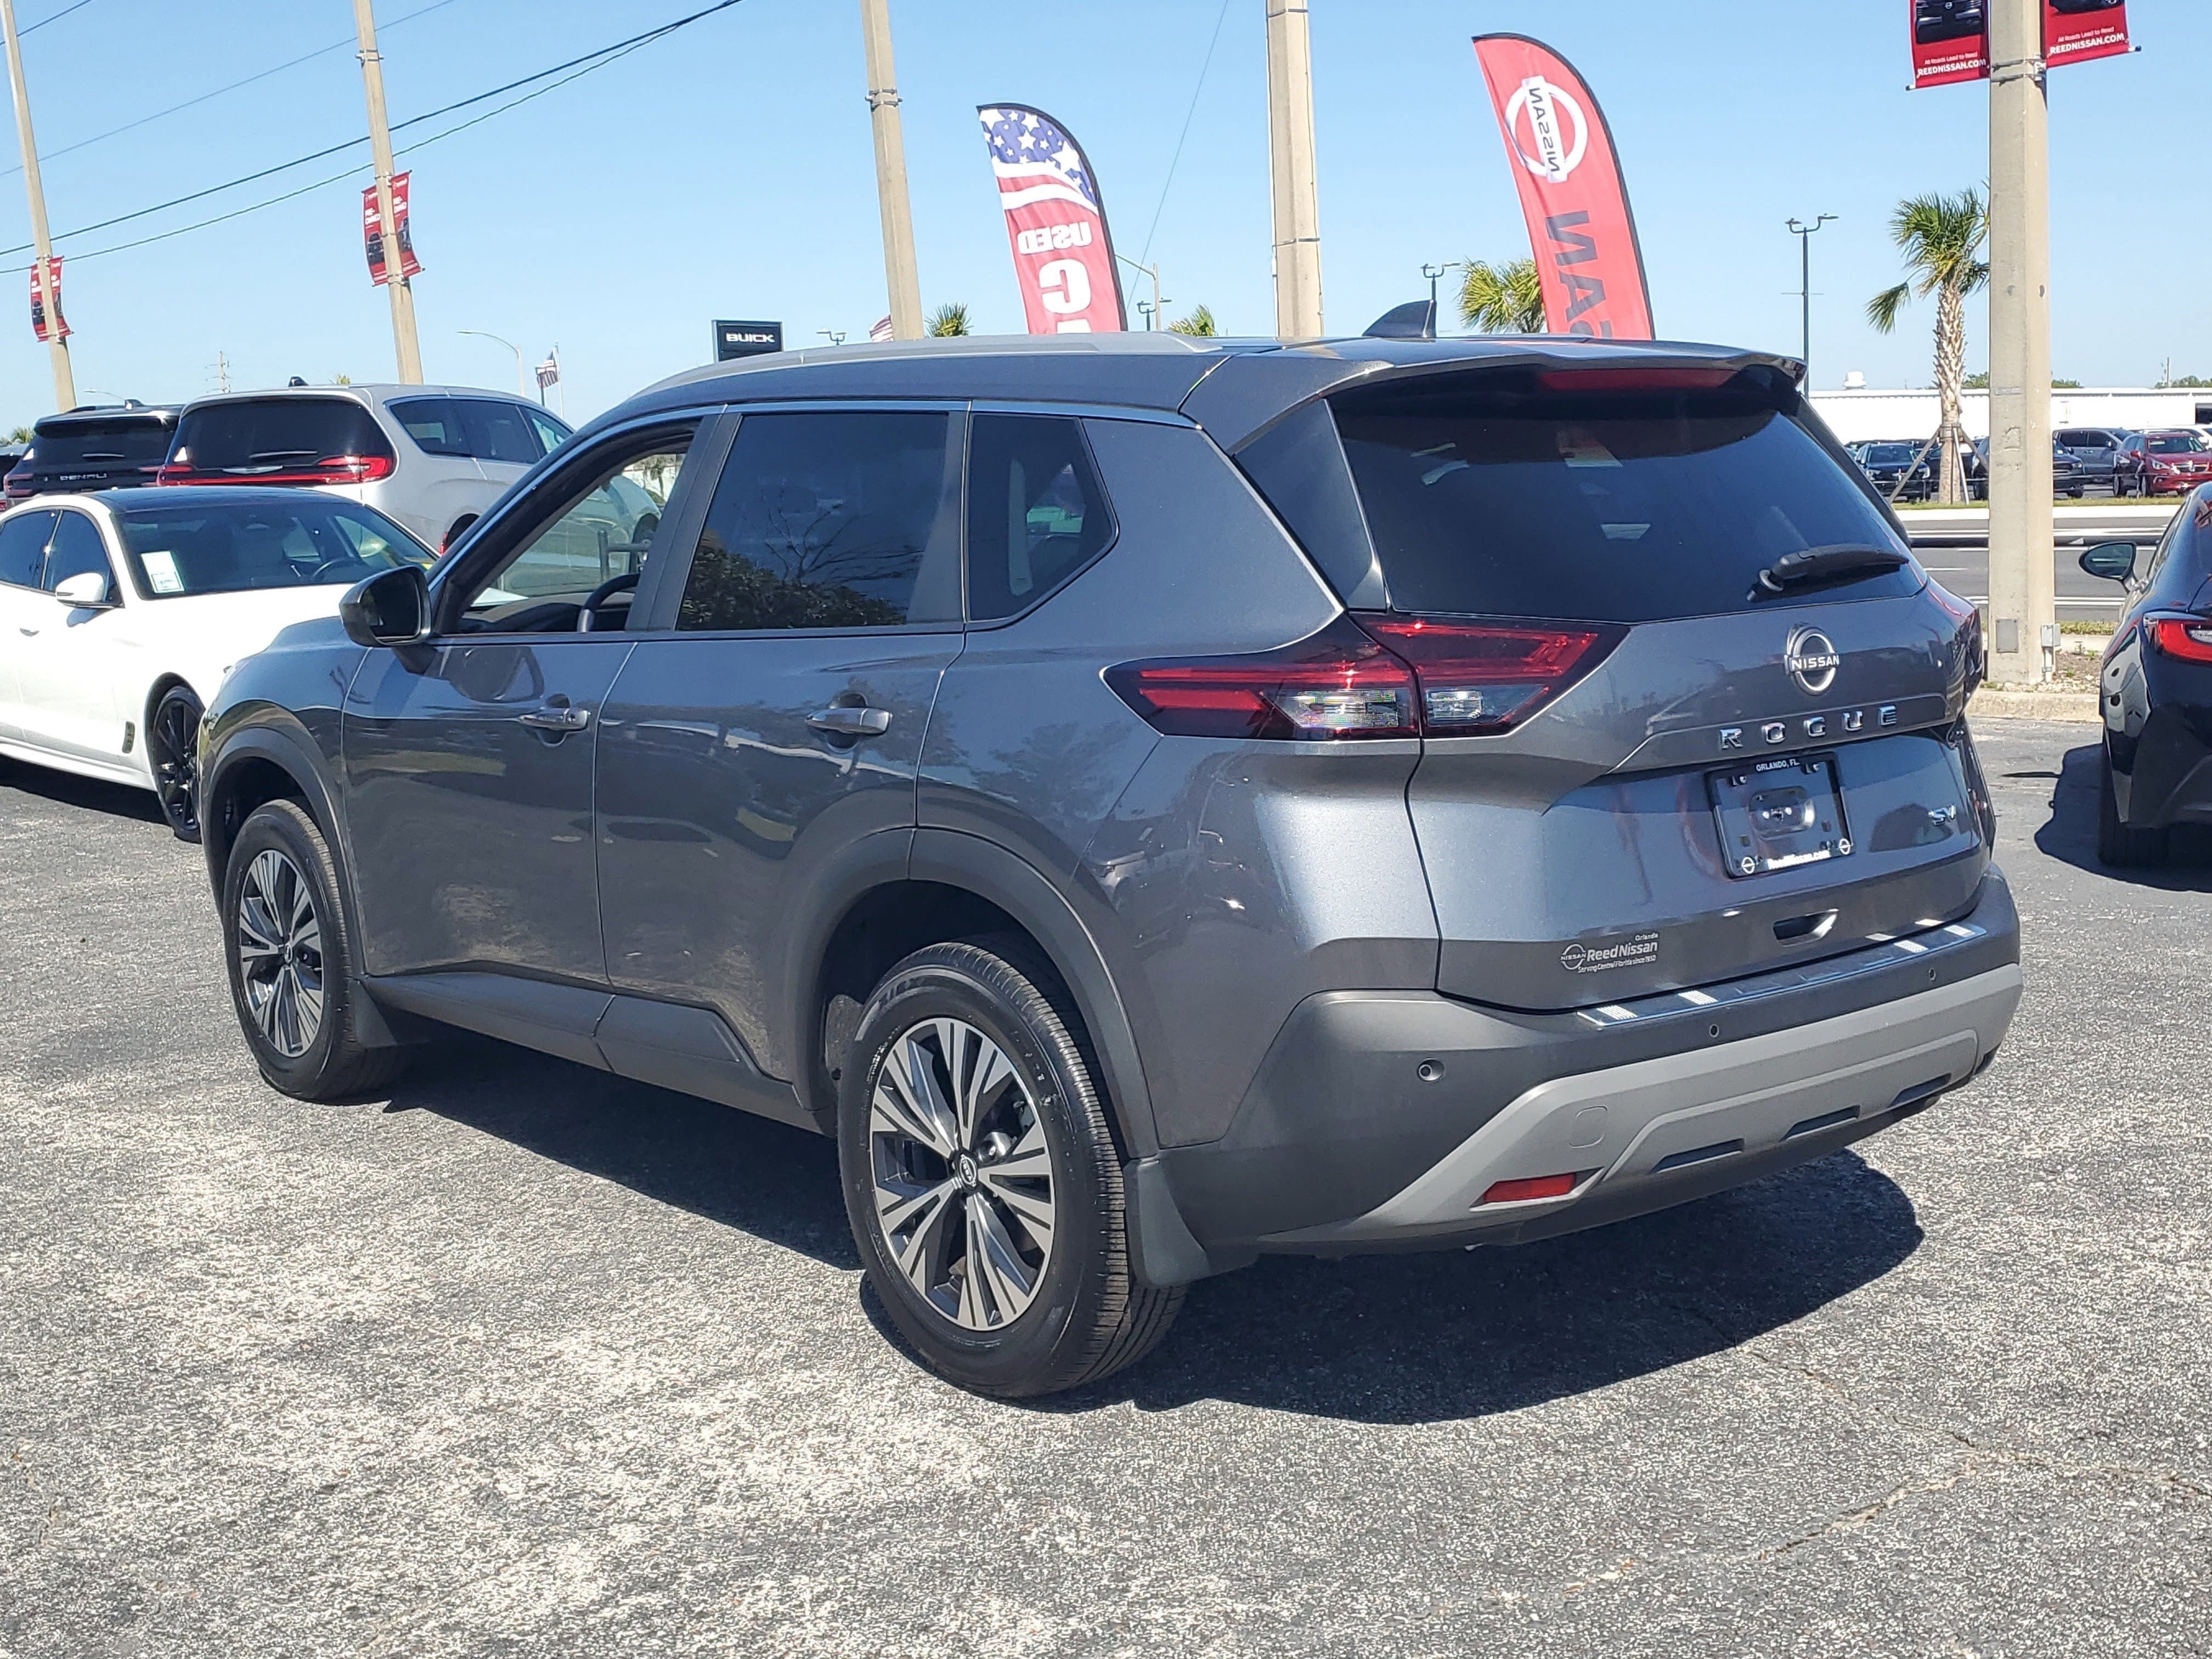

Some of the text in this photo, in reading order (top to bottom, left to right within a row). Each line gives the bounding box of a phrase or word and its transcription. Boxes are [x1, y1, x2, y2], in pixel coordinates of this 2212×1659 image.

[2050, 33, 2125, 55] REEDNISSAN.COM
[1917, 59, 1986, 76] REEDNISSAN.COM
[726, 333, 775, 343] BUICK
[1791, 656, 1839, 670] NISSAN
[1719, 705, 1898, 750] ROGUE
[1789, 758, 1801, 766] FL
[1928, 805, 1956, 826] SV
[1560, 952, 1587, 961] NISSAN
